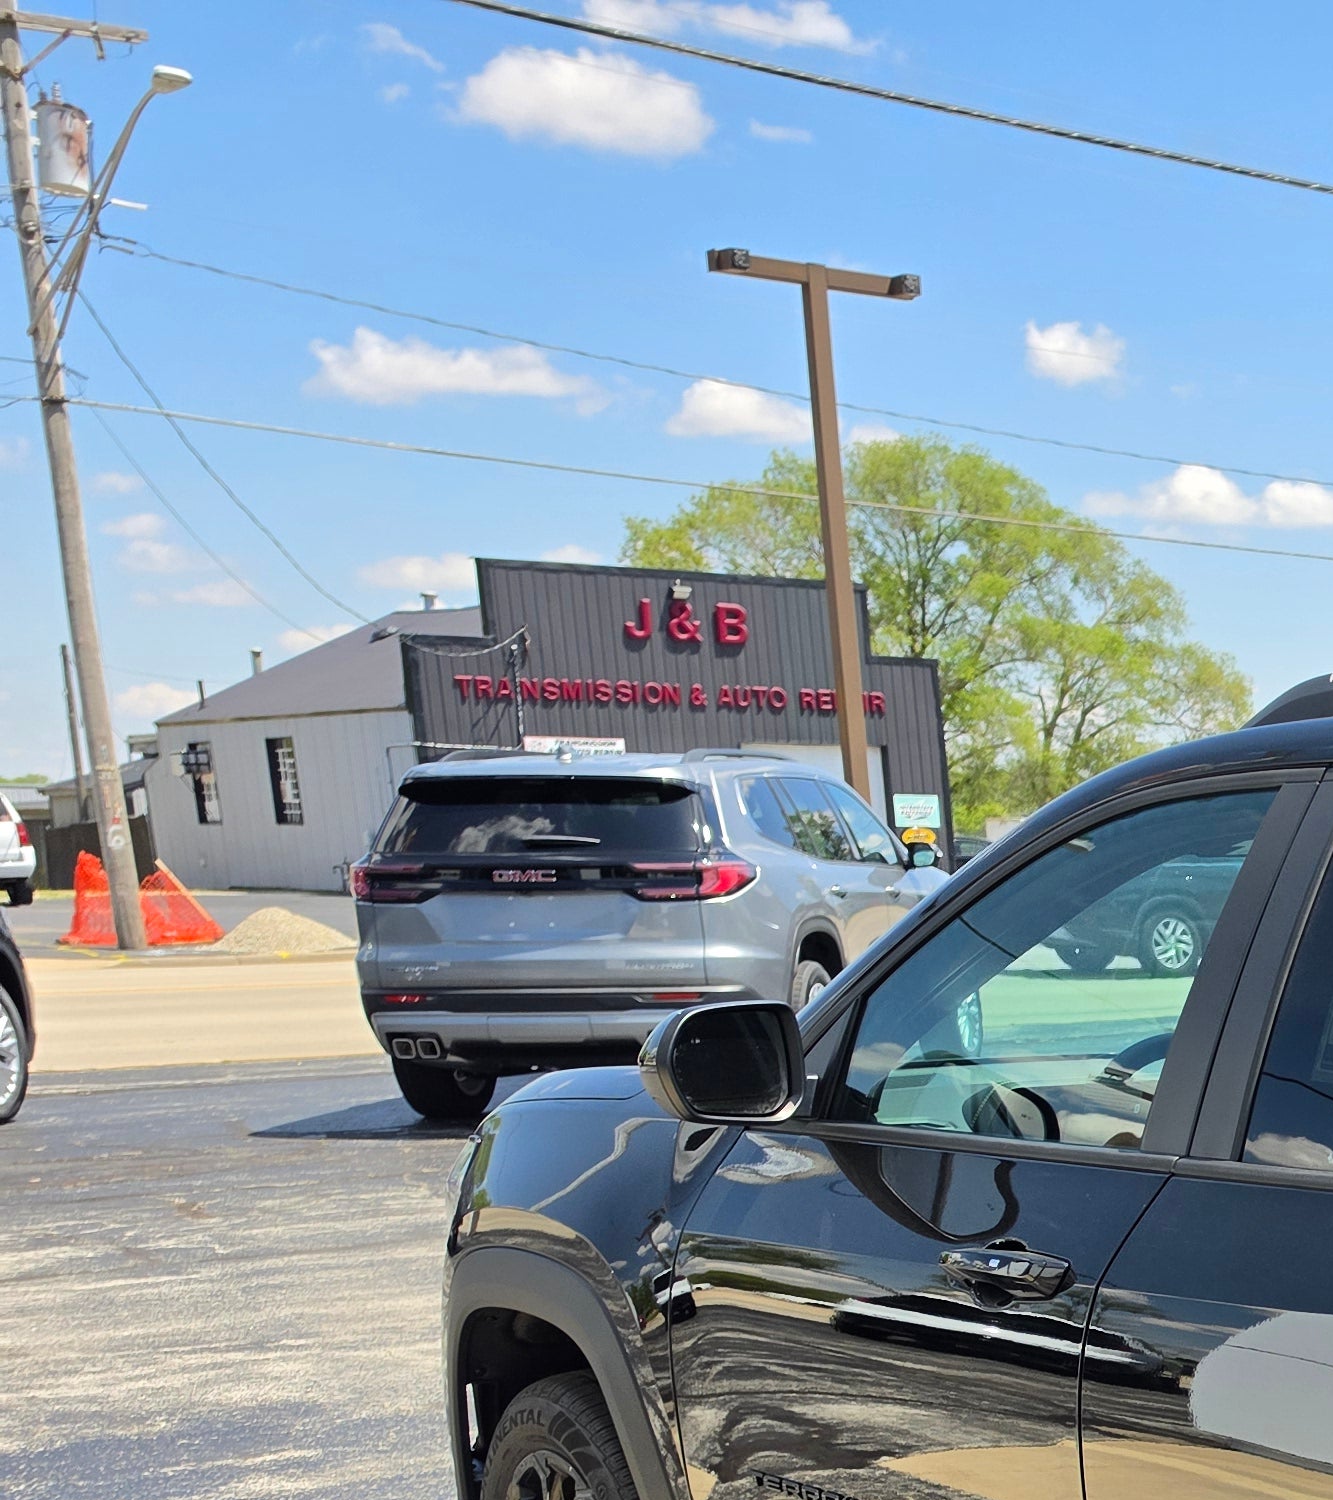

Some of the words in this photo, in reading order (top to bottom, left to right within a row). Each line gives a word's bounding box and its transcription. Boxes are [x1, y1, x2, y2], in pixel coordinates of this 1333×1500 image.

[453, 674, 681, 706] TRANSMISSION
[690, 683, 708, 706] &
[718, 684, 787, 709] AUTO
[799, 687, 886, 714] REIR
[492, 869, 557, 883] GMC
